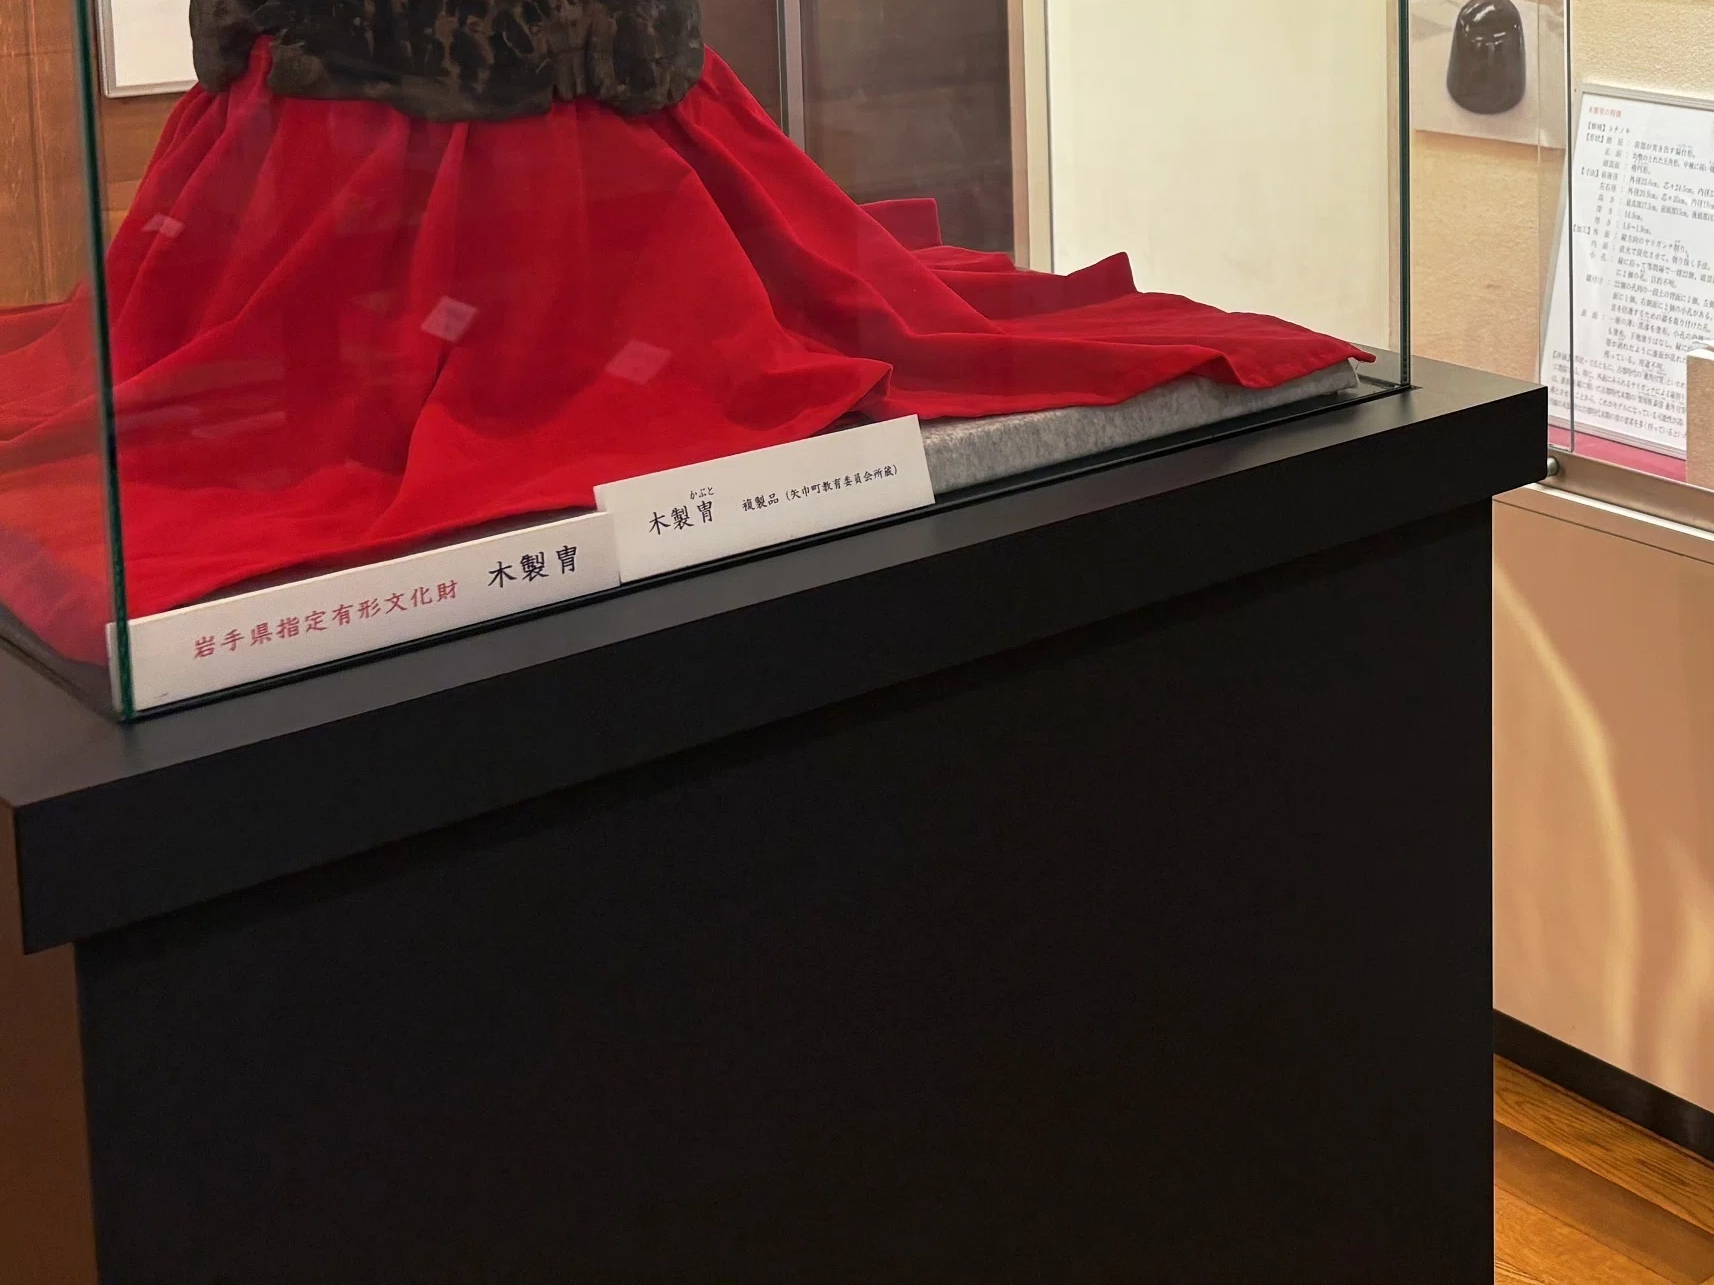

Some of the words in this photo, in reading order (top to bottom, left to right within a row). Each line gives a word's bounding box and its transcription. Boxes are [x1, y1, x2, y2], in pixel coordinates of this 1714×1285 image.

[690, 486, 715, 501] かぶと
[649, 500, 713, 535] 木製冑
[193, 580, 459, 659] 岩手県指定有形文化財
[487, 545, 579, 589] 木製冑
